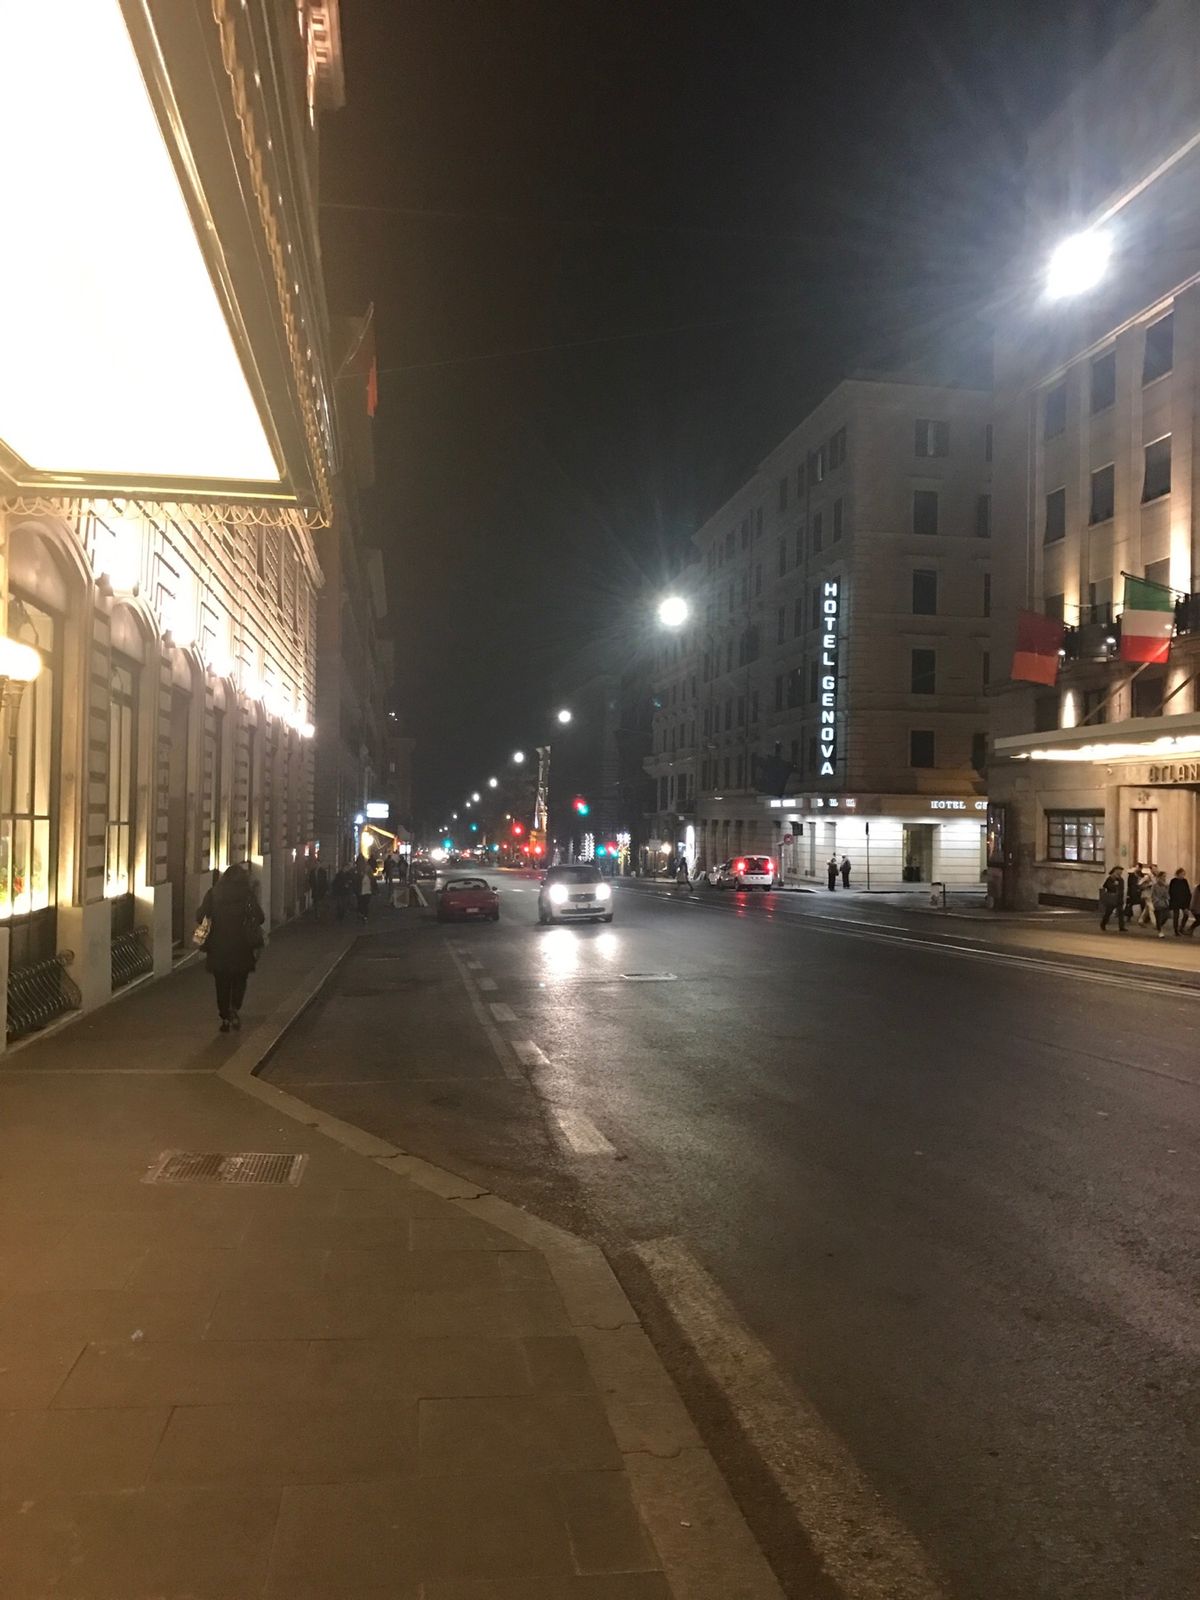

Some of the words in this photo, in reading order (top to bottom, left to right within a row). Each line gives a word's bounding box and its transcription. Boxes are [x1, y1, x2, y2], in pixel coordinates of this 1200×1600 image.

[822, 582, 838, 666] HOTEL
[820, 675, 836, 776] GENOVA
[930, 800, 967, 810] HOTEL
